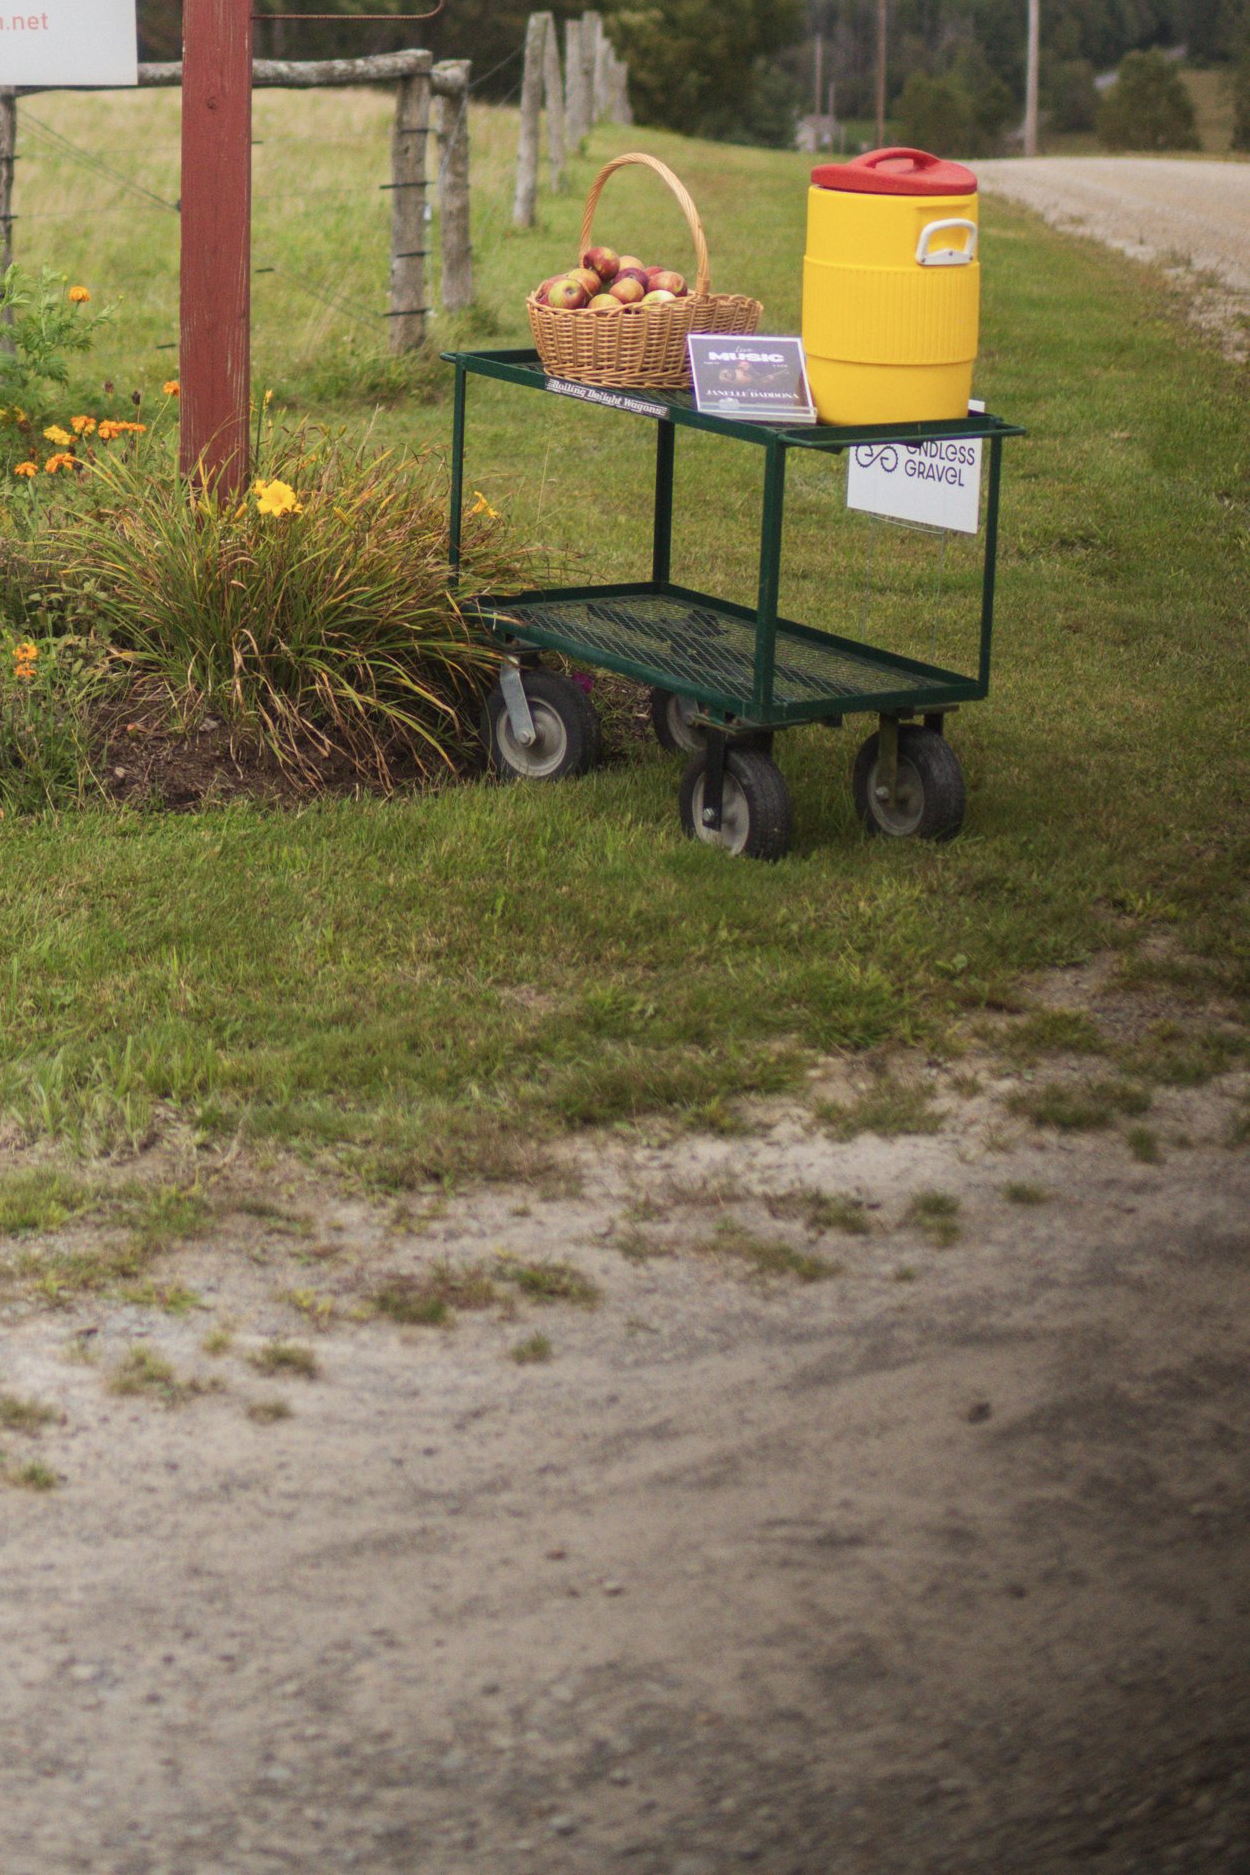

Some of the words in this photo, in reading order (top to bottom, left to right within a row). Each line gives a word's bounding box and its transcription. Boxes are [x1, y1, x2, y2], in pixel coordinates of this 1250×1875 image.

[708, 351, 785, 363] MUSIC
[553, 379, 586, 397] Rolling
[588, 388, 623, 405] Delight
[624, 397, 662, 415] Wagons
